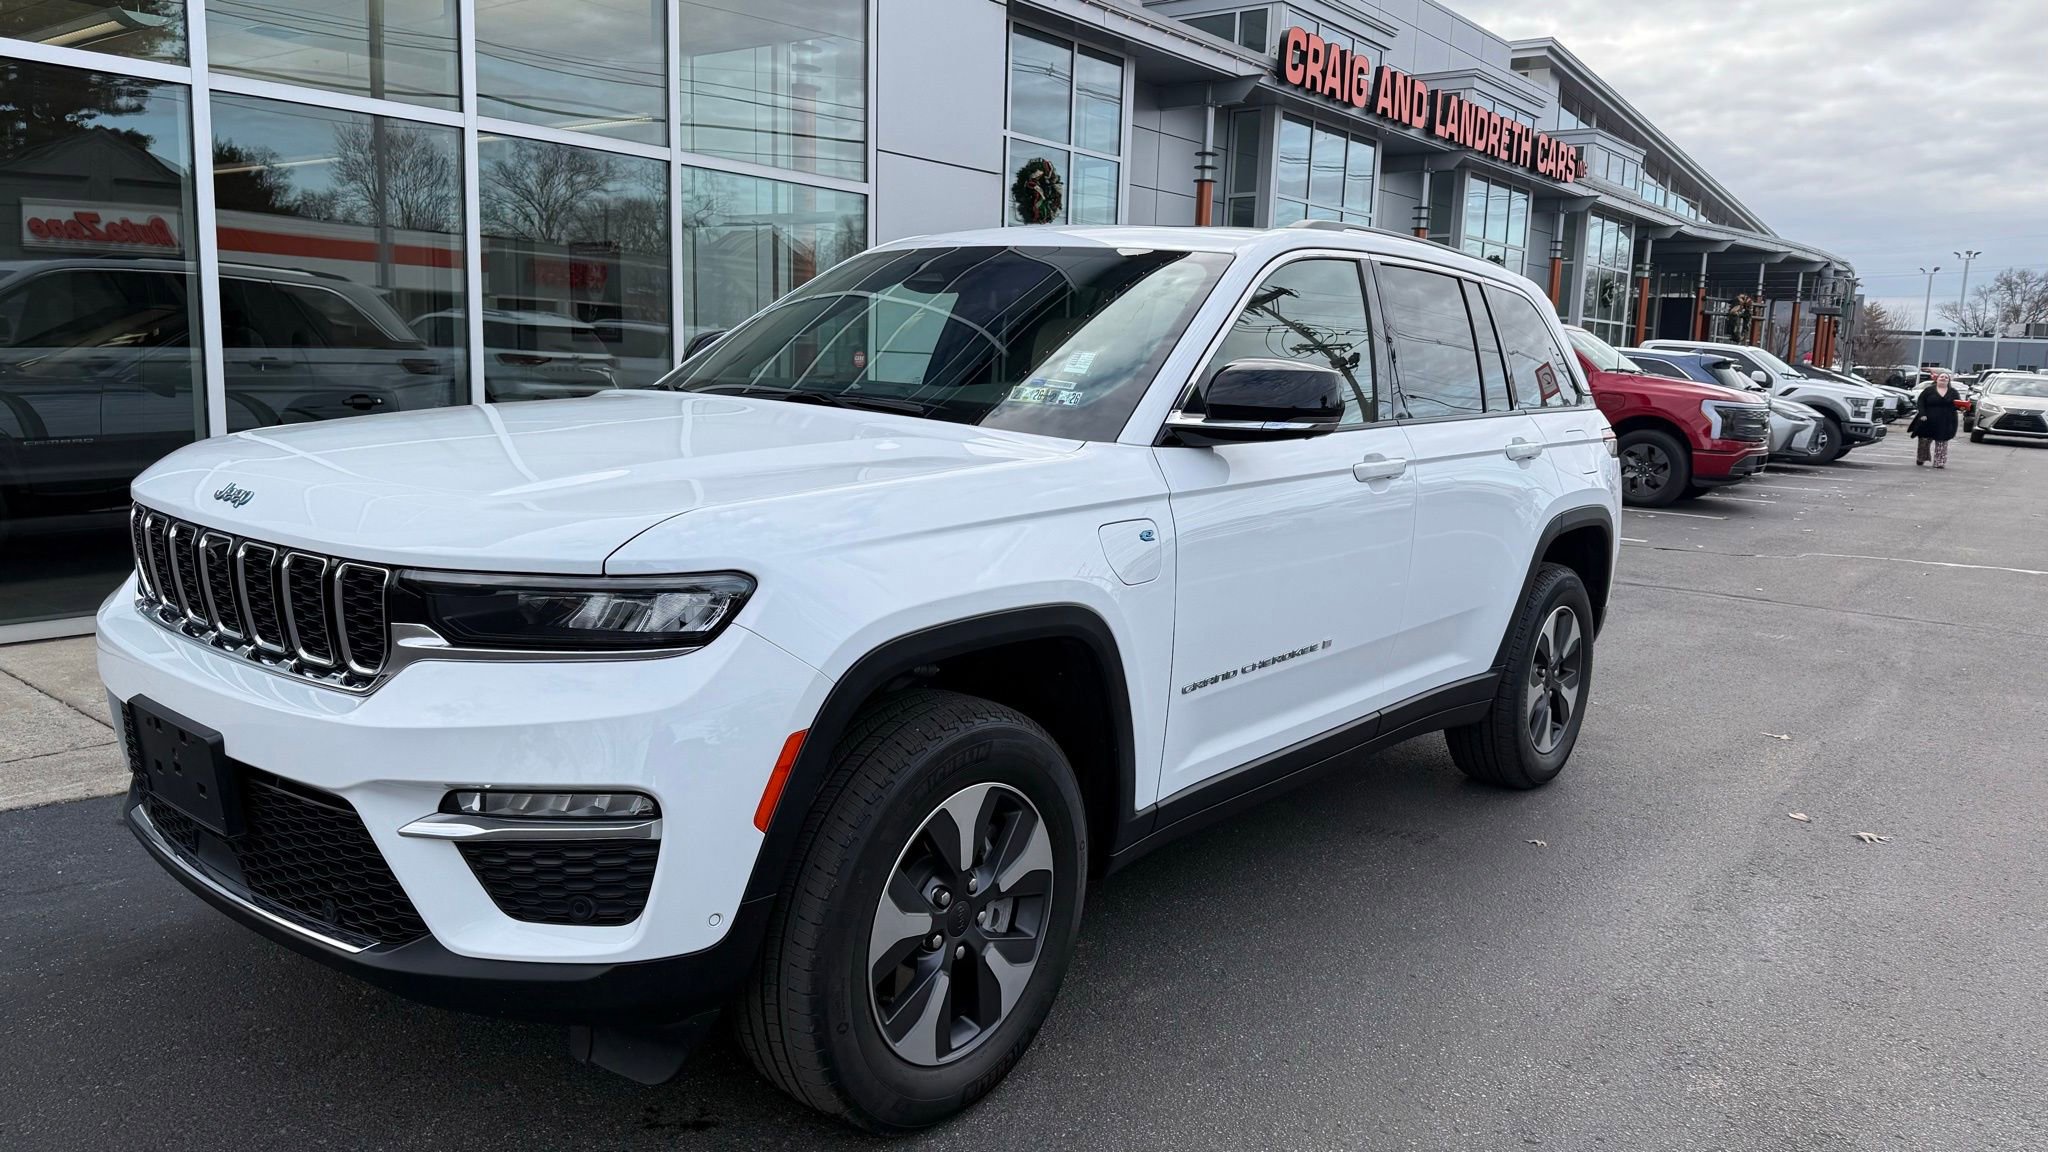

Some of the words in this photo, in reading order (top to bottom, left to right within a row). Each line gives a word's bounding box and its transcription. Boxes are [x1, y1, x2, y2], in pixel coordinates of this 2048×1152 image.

[1283, 26, 1370, 108] CRAIG
[1376, 66, 1427, 130] AND
[1434, 89, 1533, 168] LANDRETH
[1537, 134, 1576, 183] CARS
[214, 482, 254, 508] Jeep
[1181, 669, 1238, 695] GRAND
[1241, 643, 1319, 675] CHEROKEE
